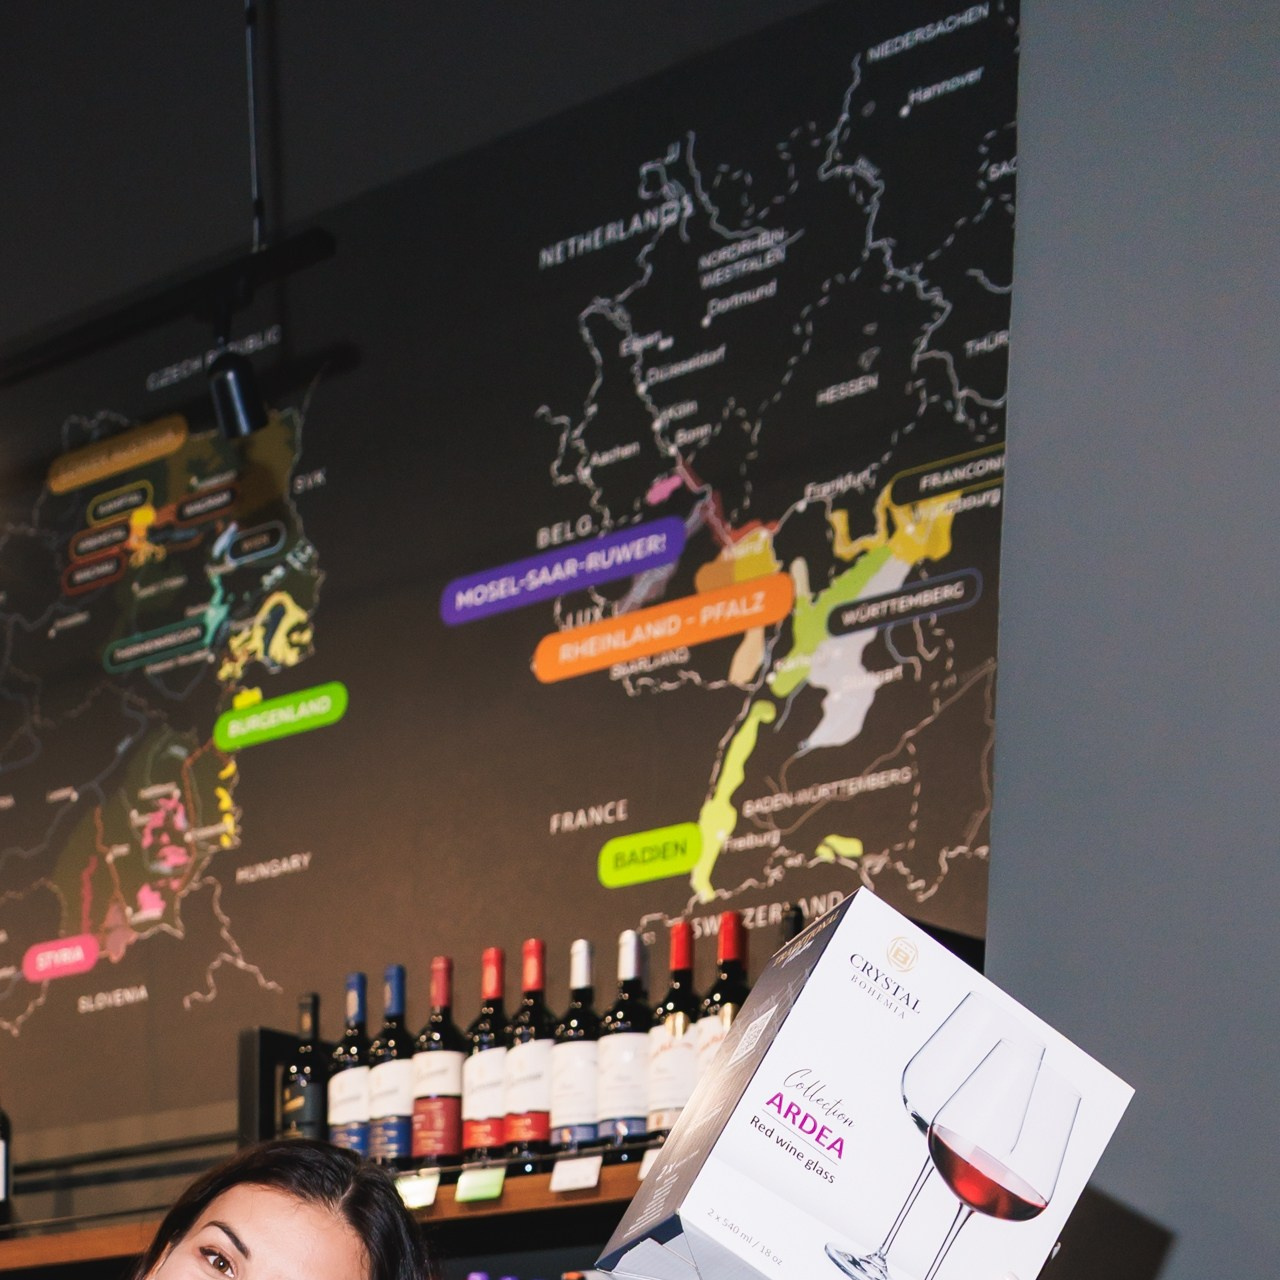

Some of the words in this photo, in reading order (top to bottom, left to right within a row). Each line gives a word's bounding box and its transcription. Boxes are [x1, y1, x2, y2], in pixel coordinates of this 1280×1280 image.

[816, 372, 880, 407] HESSEN
[558, 616, 683, 664] RHEINLAND
[700, 590, 767, 626] PFALZ
[549, 799, 629, 835] FRANCE
[613, 838, 688, 872] BADEN
[850, 953, 921, 1015] CRYSTAL
[850, 974, 906, 1020] BOHEMIA
[765, 1091, 845, 1160] ARDEA
[783, 1068, 855, 1128] Collection
[749, 1115, 775, 1139] Red
[775, 1135, 805, 1161] wine
[804, 1160, 836, 1184] glass
[707, 1208, 715, 1217] 2
[721, 1217, 740, 1235] 540
[739, 1229, 754, 1245] ml
[759, 1245, 773, 1259] 18
[771, 1255, 784, 1267] oz
